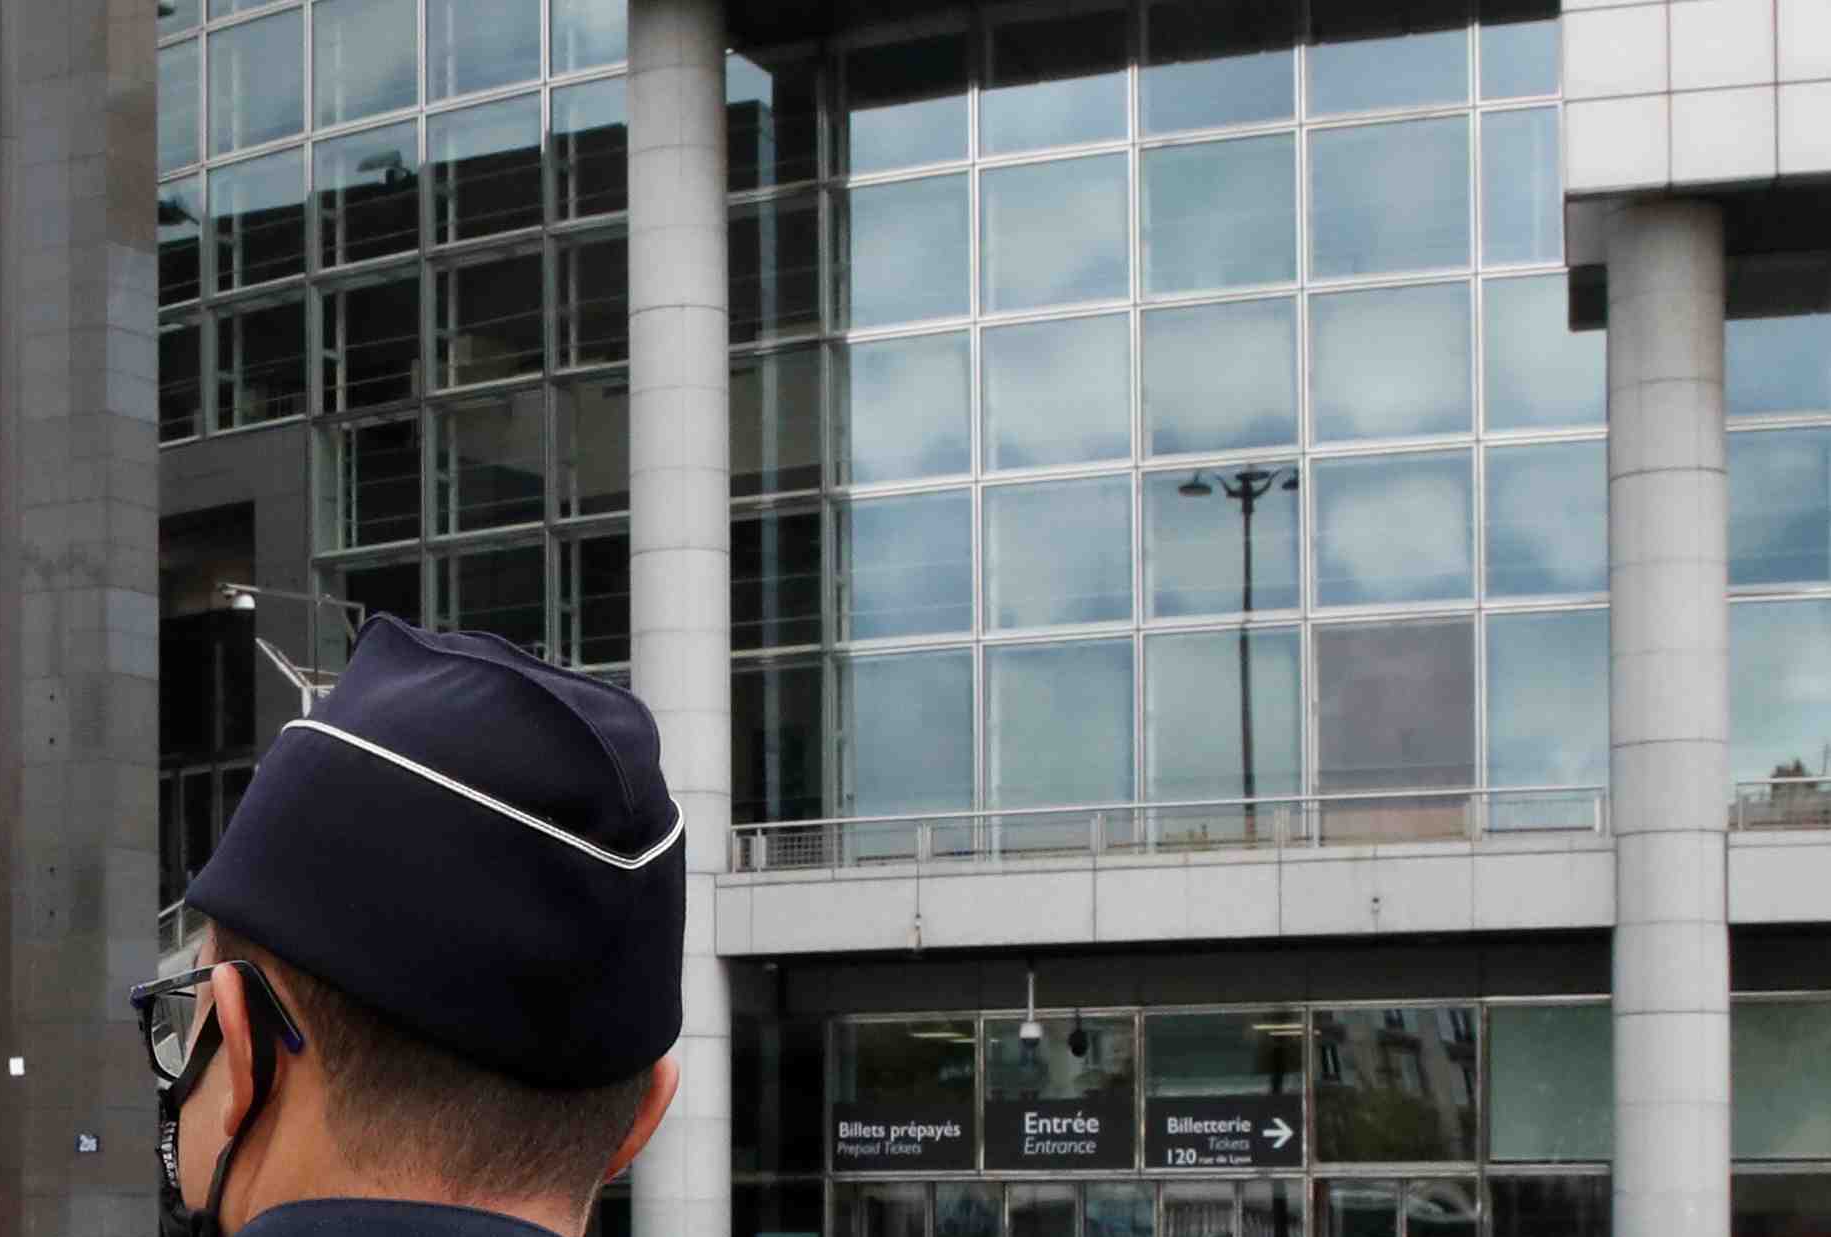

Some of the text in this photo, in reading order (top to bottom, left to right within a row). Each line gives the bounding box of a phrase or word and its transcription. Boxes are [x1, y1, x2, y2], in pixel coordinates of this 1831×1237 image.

[838, 1120, 962, 1141] Billets prépayés
[1024, 1110, 1100, 1134] Entrée
[1167, 1115, 1251, 1134] Billetterie
[1023, 1136, 1097, 1154] Entrance
[1167, 1148, 1197, 1165] 120
